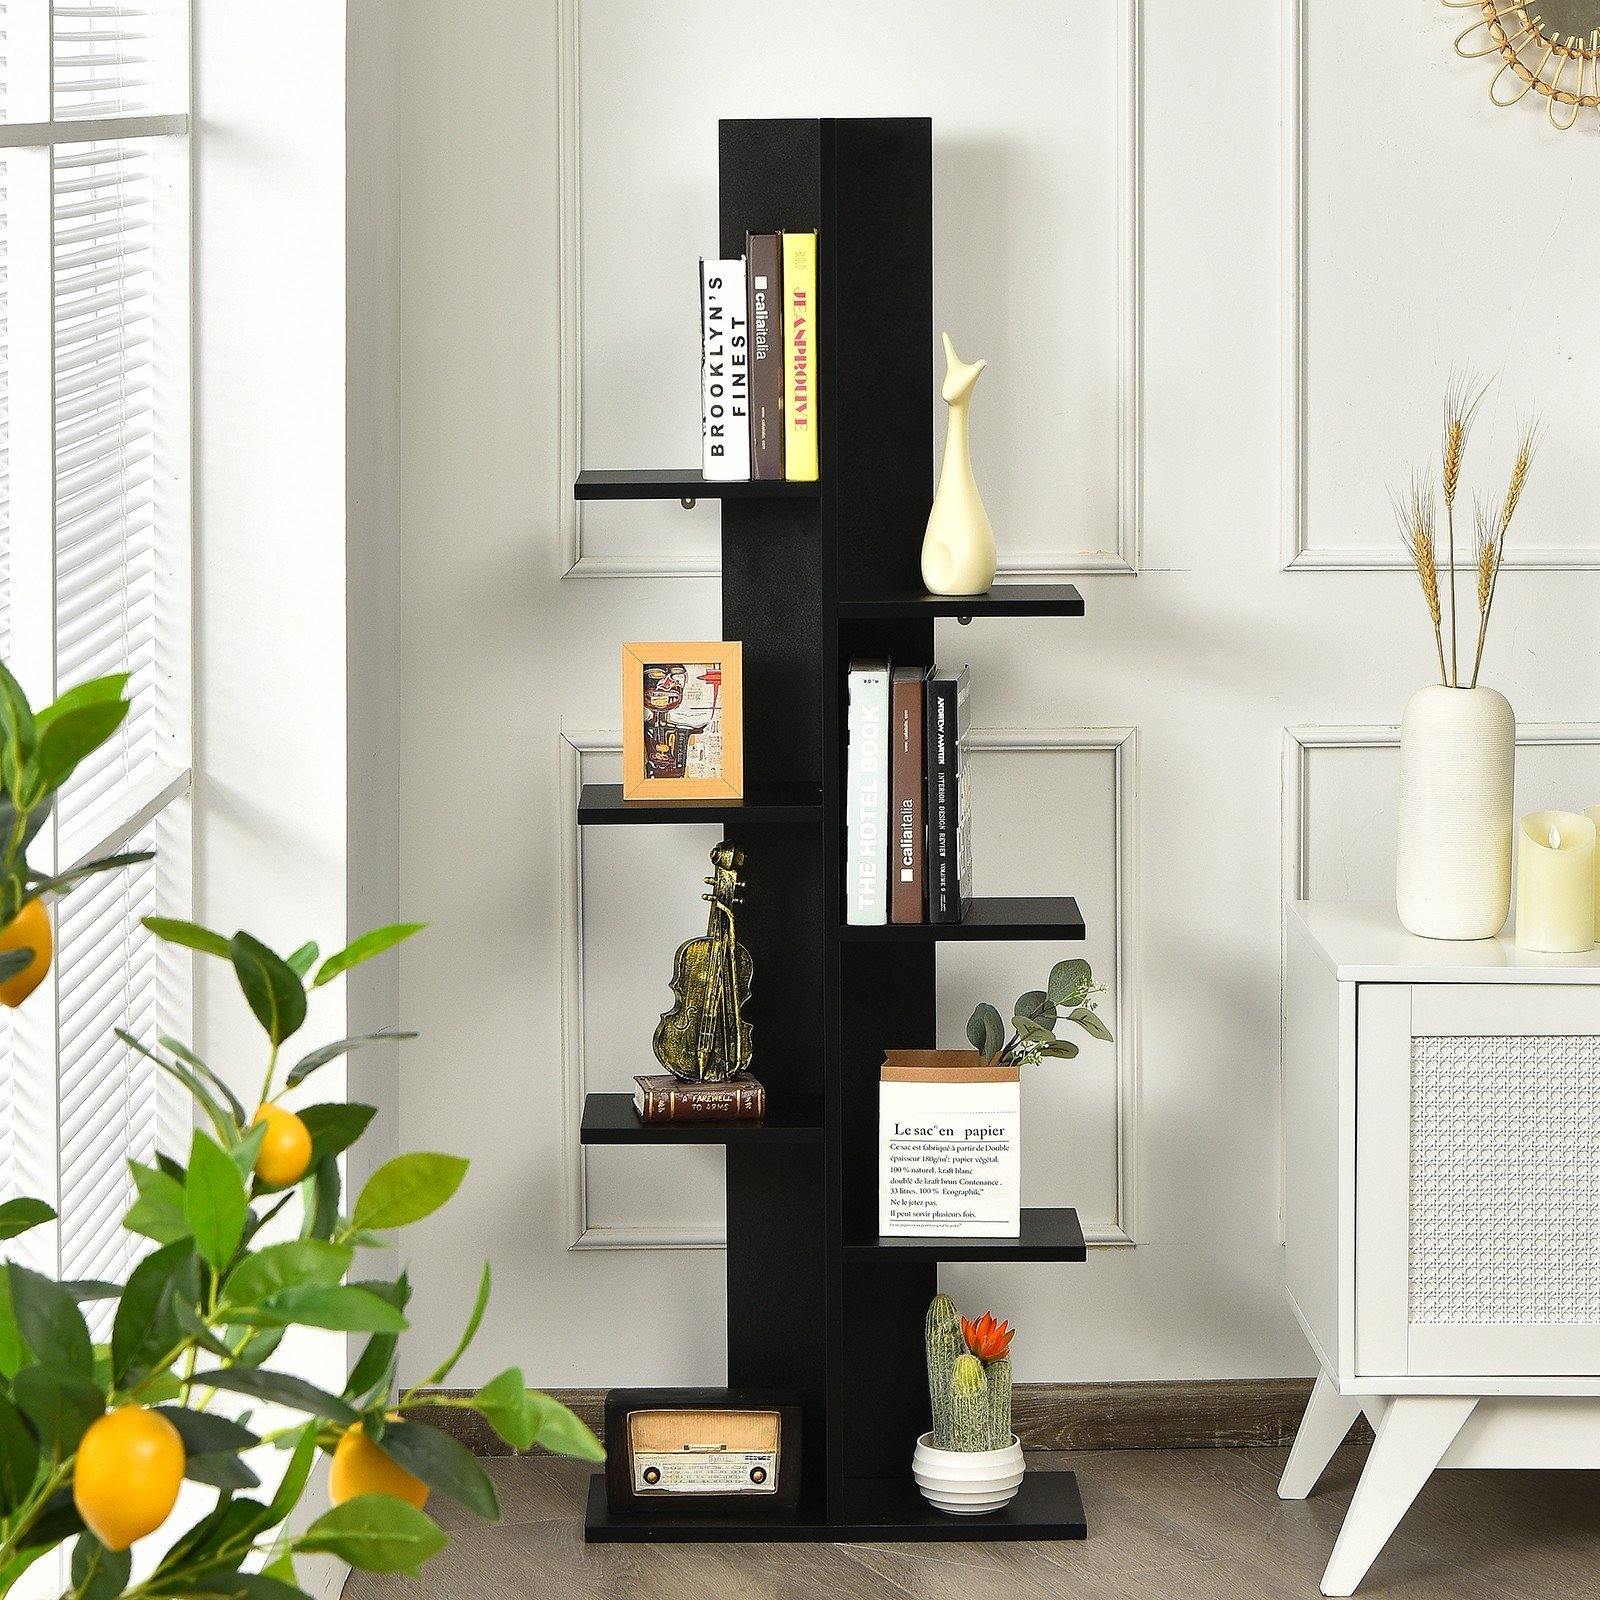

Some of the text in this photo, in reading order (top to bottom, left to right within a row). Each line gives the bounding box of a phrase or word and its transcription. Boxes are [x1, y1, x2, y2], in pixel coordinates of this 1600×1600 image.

[754, 292, 769, 360] caliaitalia
[708, 277, 725, 457] BROOKLYN'S
[731, 316, 746, 417] FINEST
[937, 696, 945, 765] ANDREW MARTIN
[858, 703, 881, 911] THE HOTEL BOOK
[937, 772, 946, 858] INTERIOR DESIGN REVIEW
[899, 798, 914, 866] caliaitalia
[681, 1093, 733, 1103] A FAREWELL
[691, 1103, 731, 1111] TO ARMS
[894, 1122, 911, 1136] Le
[939, 1127, 954, 1136] en
[965, 1125, 1005, 1140] papier
[890, 1143, 900, 1151] Ce
[956, 1145, 975, 1153] partir
[985, 1144, 1010, 1152] Double
[952, 1156, 973, 1164] papier
[958, 1178, 999, 1186] Contenance
[907, 1199, 923, 1207] jetez
[896, 1210, 911, 1218] peut
[932, 1210, 962, 1219] plusieurs
